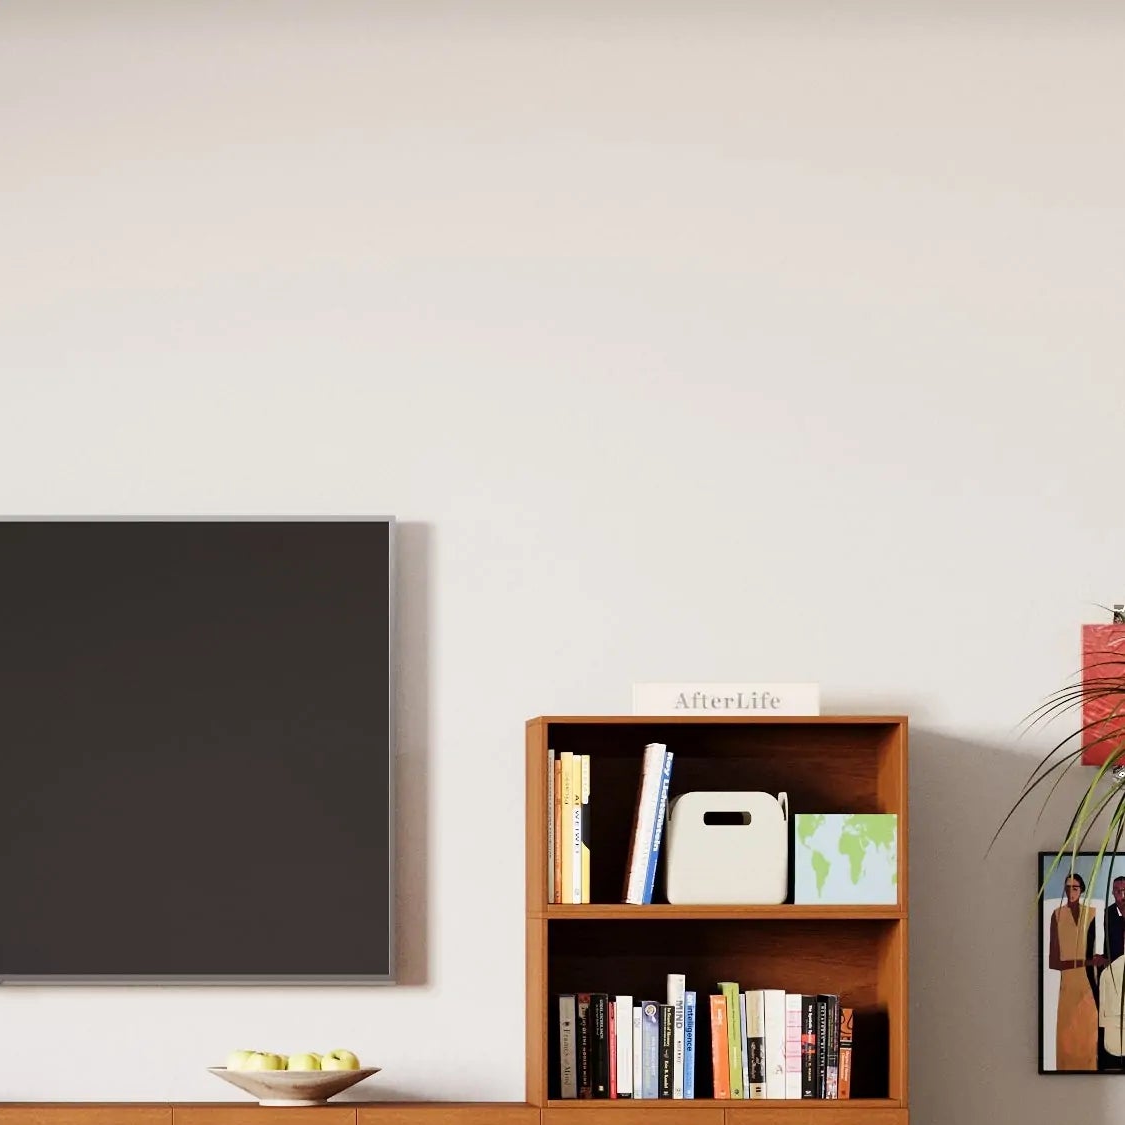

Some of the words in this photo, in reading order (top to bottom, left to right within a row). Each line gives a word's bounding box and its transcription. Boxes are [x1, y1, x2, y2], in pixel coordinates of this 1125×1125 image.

[674, 691, 782, 710] AfterLife
[663, 752, 674, 777] Roy
[652, 778, 670, 852] Lichtenstein
[675, 1000, 683, 1029] MIND
[685, 1005, 694, 1052] intelligence
